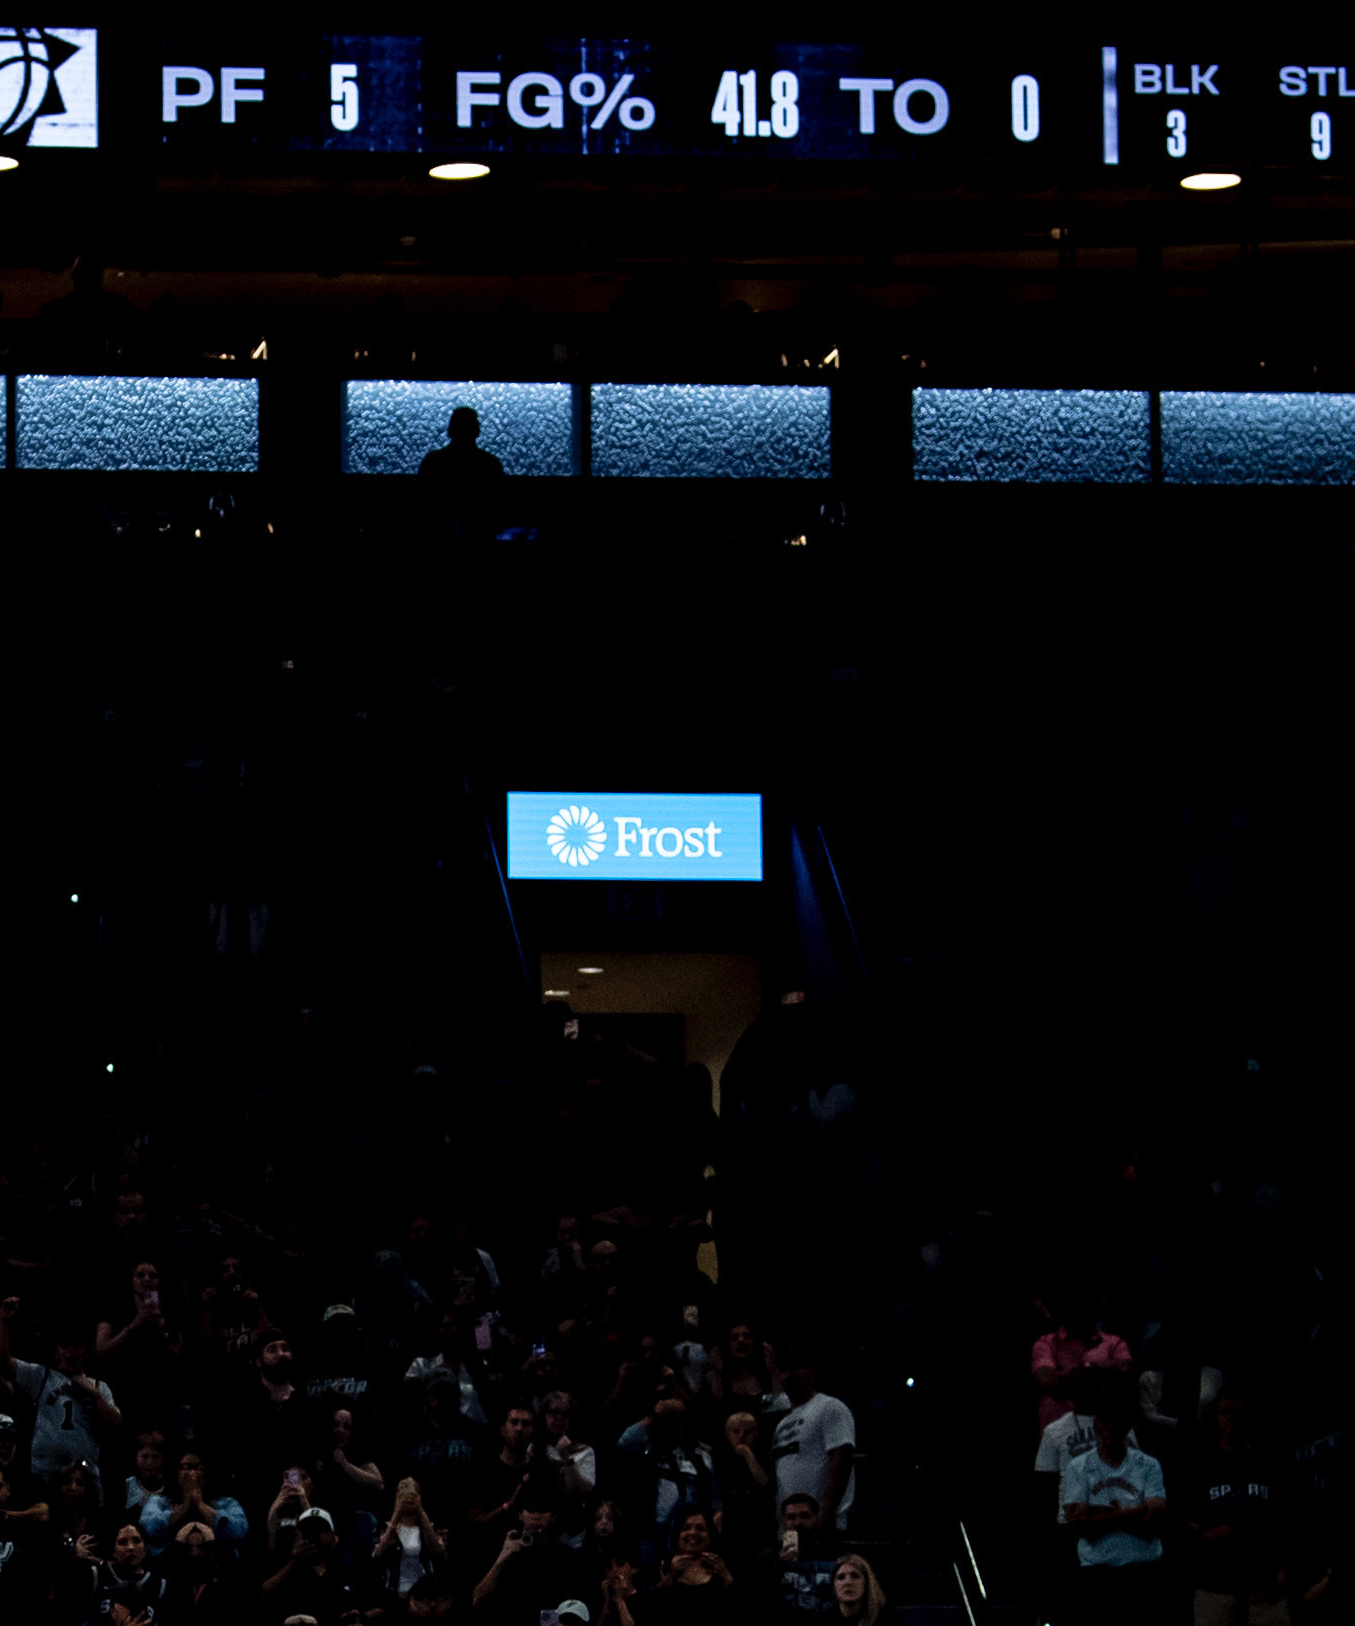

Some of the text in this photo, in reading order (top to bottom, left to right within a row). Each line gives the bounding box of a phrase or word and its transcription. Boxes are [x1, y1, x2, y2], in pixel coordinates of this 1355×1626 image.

[163, 63, 1039, 141] PF 5 FG% 41.8 TO 0
[1135, 64, 1355, 96] BLK STL
[1167, 107, 1331, 161] 3 9
[614, 817, 722, 857] Frost
